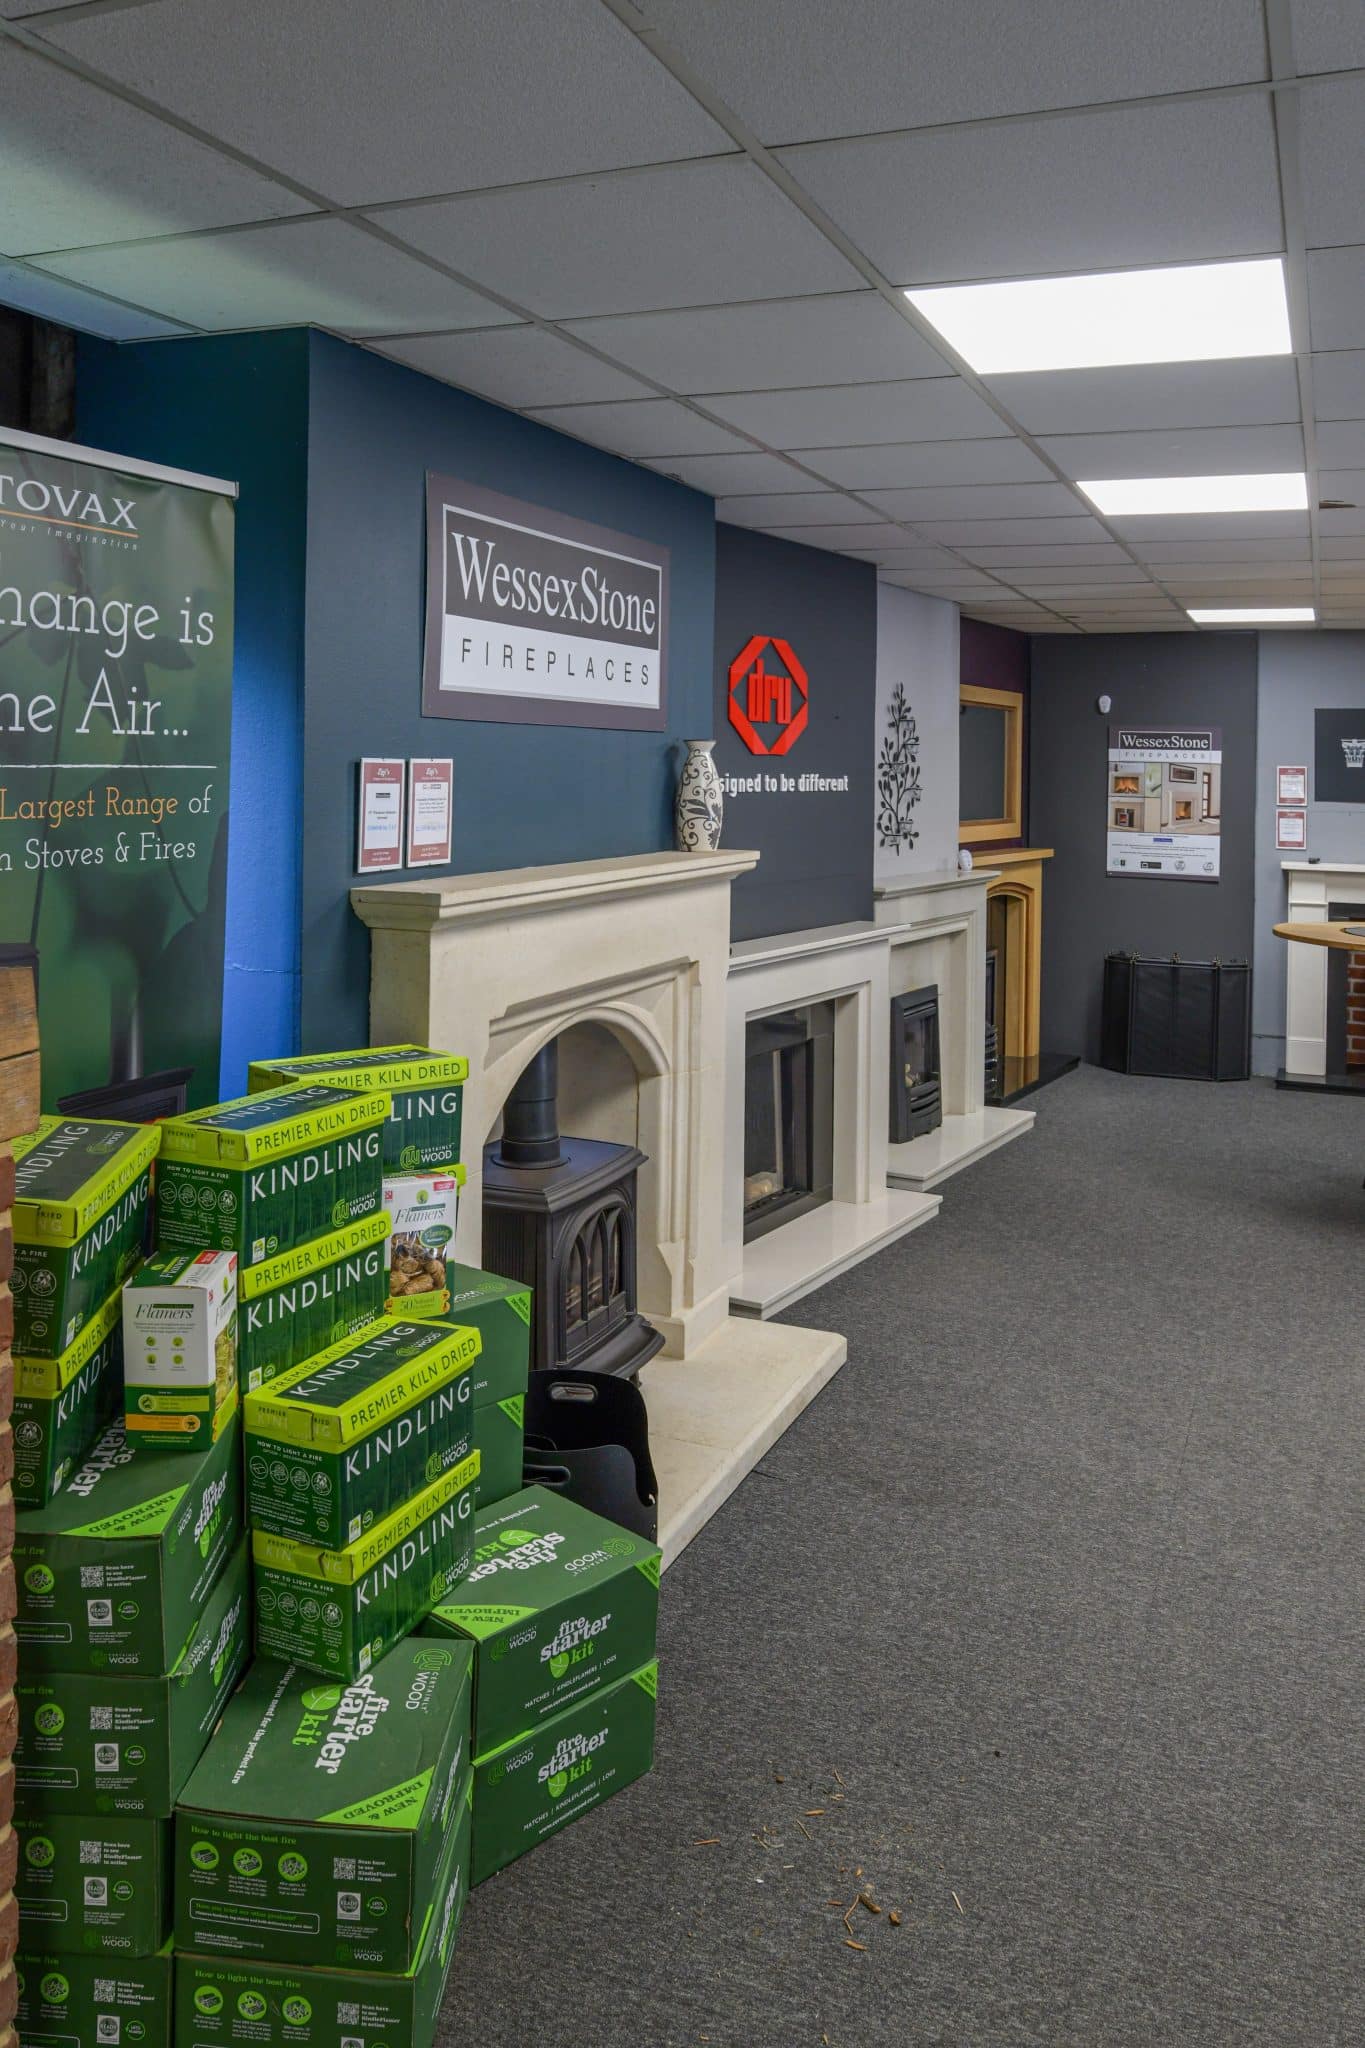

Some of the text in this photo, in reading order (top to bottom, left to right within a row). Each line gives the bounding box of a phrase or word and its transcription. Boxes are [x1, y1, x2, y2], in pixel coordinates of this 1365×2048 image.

[451, 532, 656, 636] WessexStone
[179, 597, 214, 646] is
[461, 638, 650, 686] FIREPLACES
[1121, 734, 1209, 749] WessexStone
[1124, 751, 1206, 759] FIREPLACES
[765, 774, 777, 792] to
[780, 774, 795, 792] be
[798, 774, 849, 792] different
[0, 785, 214, 828] Largest Range of
[24, 831, 197, 870] Stoves & Fires
[379, 1062, 461, 1085] KILN DRIED
[255, 1100, 386, 1153] PREMIER KILN DRIED
[250, 1132, 380, 1202] KINDLING
[421, 1149, 453, 1162] WOOD
[71, 1174, 149, 1279] KINDLING
[349, 1198, 376, 1216] WOOD
[395, 1207, 446, 1224] Flamers
[255, 1220, 387, 1288] PREMIER KILN DRIED
[135, 1303, 193, 1319] Flamers
[247, 1251, 379, 1333] KINDLING
[66, 1324, 101, 1378] PREMIER
[270, 1361, 320, 1392] PREMIER
[353, 1321, 389, 1341] DRIED
[290, 1326, 416, 1397] KINDLING
[350, 1338, 477, 1431] PREMIER KILN DRIED
[346, 1377, 470, 1482] KINDLING
[441, 1443, 468, 1468] WOOD
[89, 1494, 176, 1533] IMPROVED
[130, 1506, 168, 1528] NEW
[361, 1462, 476, 1568] PREMIER KILN DRIED
[356, 1491, 471, 1612] KINDLING
[467, 1532, 566, 1583] starter
[514, 1549, 558, 1570] fire
[564, 1550, 608, 1571] WOOD
[444, 1559, 469, 1585] WOOD
[444, 1608, 520, 1616] IMPROVED
[558, 1616, 586, 1638] fire
[509, 1631, 537, 1649] WOOD
[540, 1614, 612, 1662] starter
[571, 1642, 594, 1664] kit
[405, 1671, 426, 1710] WOOD
[423, 1671, 439, 1714] CERTAINLY
[524, 1691, 550, 1709] MATCHES
[603, 1655, 617, 1666] LOGS
[292, 1712, 328, 1746] kit
[315, 1674, 376, 1774] starter
[356, 1696, 390, 1736] fire
[506, 1752, 534, 1773] WOOD
[538, 1728, 609, 1783] starter
[556, 1733, 583, 1756] fire
[231, 1769, 246, 1784] fire
[569, 1757, 593, 1782] kit
[343, 1780, 424, 1820] IMPROVED
[383, 1796, 418, 1816] NEW
[523, 1812, 549, 1831] MATCHES
[602, 1768, 616, 1782] LOGS
[102, 1939, 131, 1947] WOOD
[354, 1953, 383, 1962] WOOD
